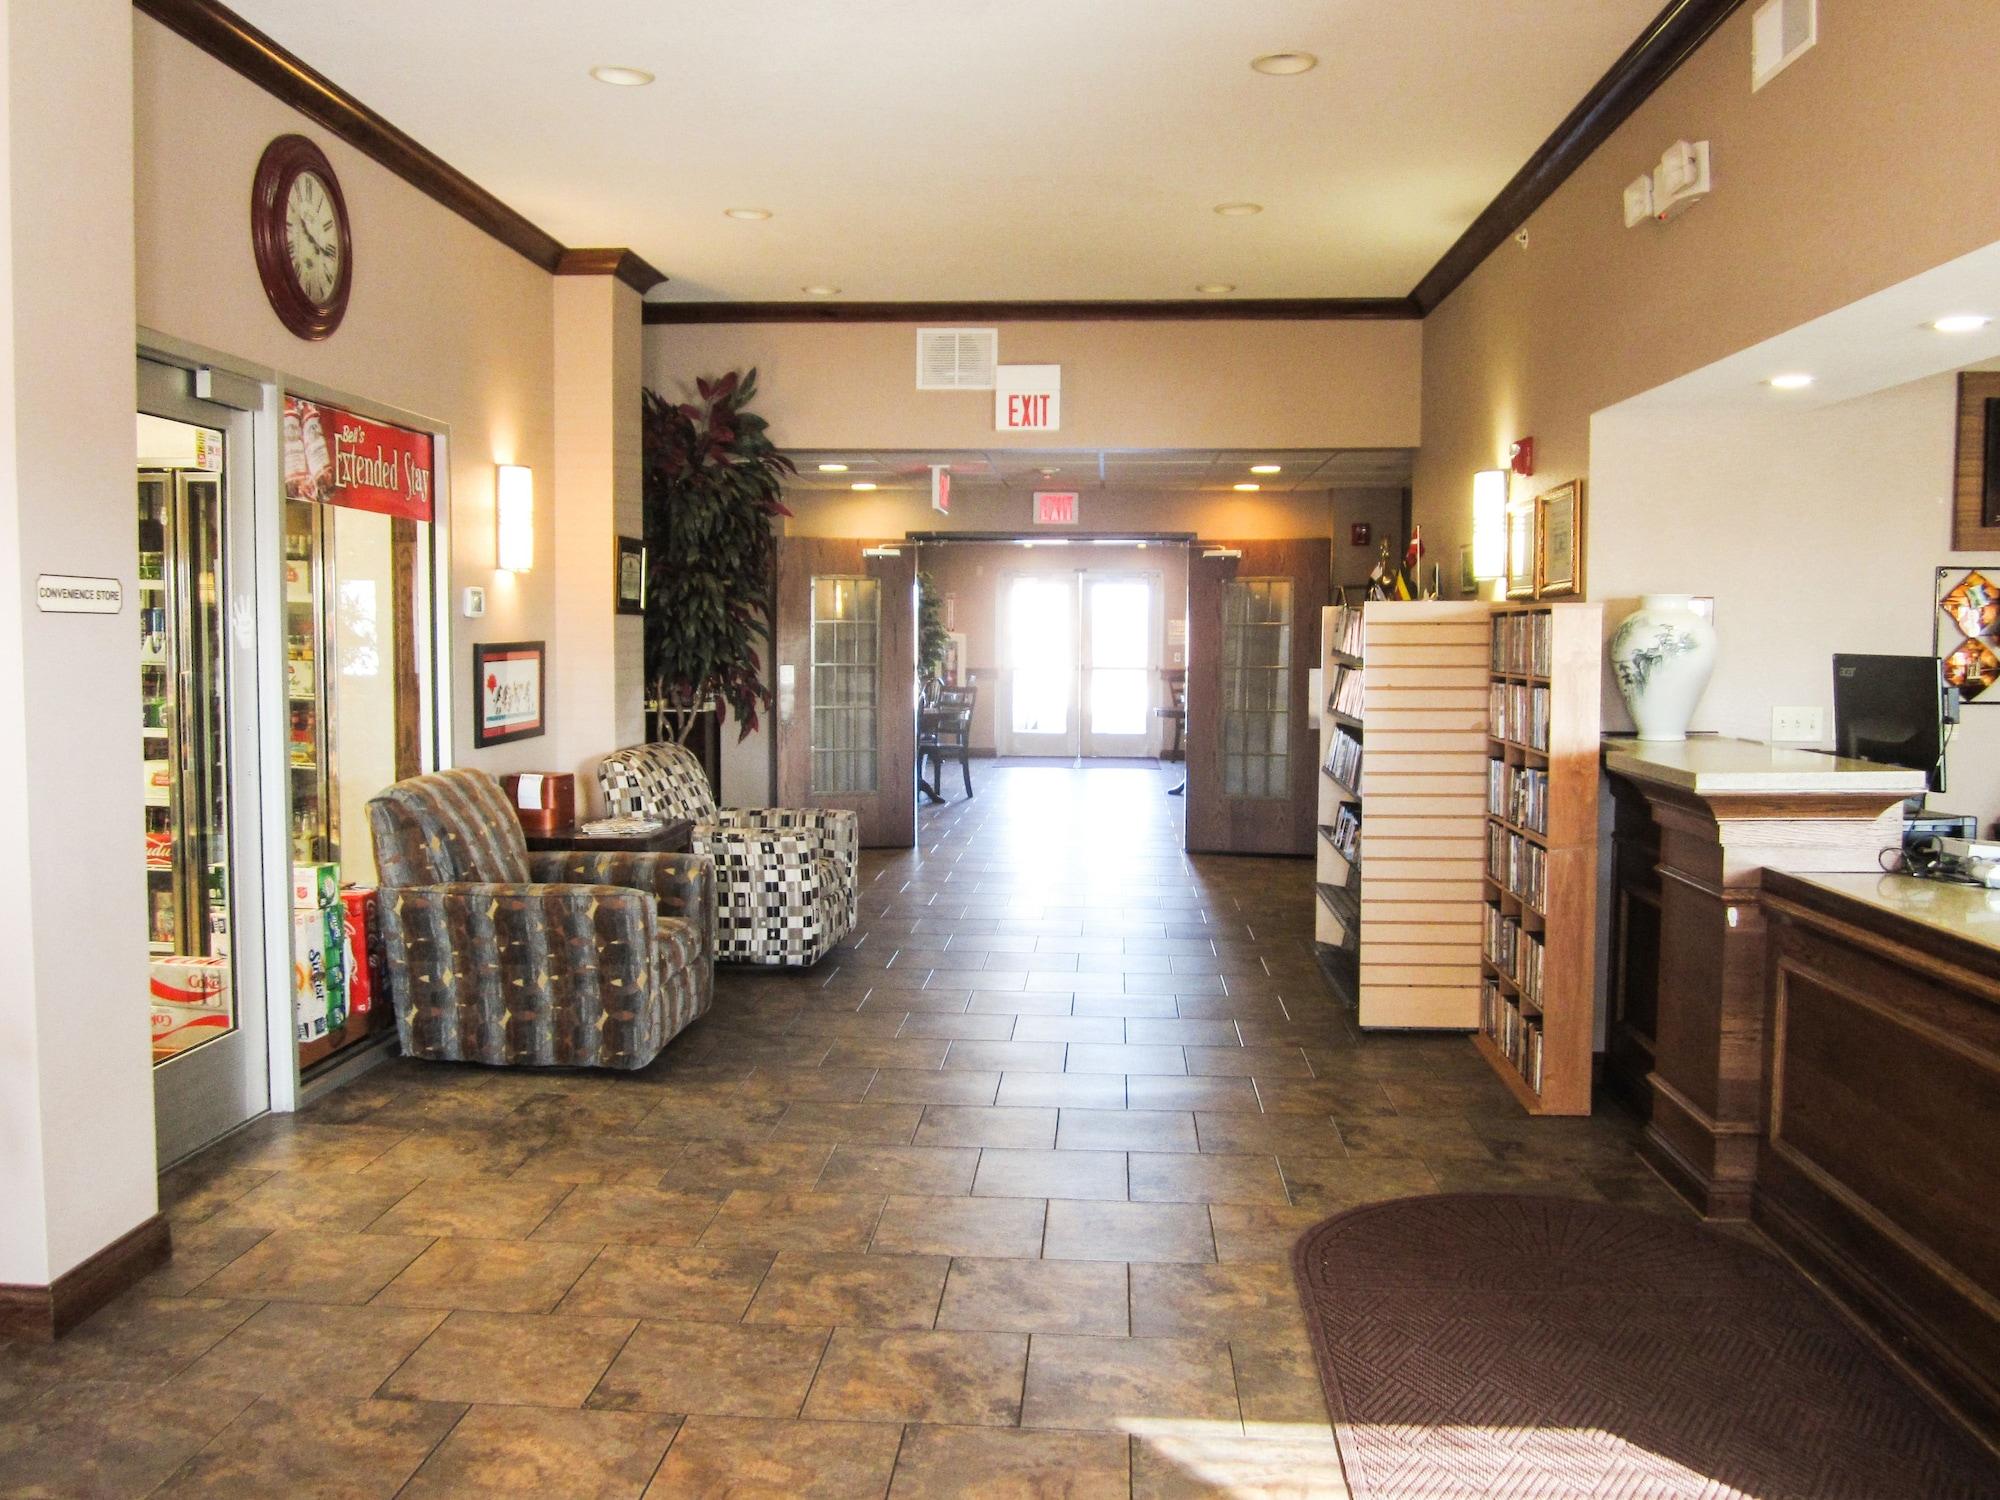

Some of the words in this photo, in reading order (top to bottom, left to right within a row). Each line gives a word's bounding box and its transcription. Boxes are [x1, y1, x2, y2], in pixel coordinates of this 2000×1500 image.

[1009, 394, 1050, 427] EXIT
[334, 433, 398, 491] Extended
[404, 452, 430, 502] Stay
[40, 587, 94, 600] CONVENIENCE
[96, 590, 120, 601] STORE
[188, 974, 220, 989] Coke
